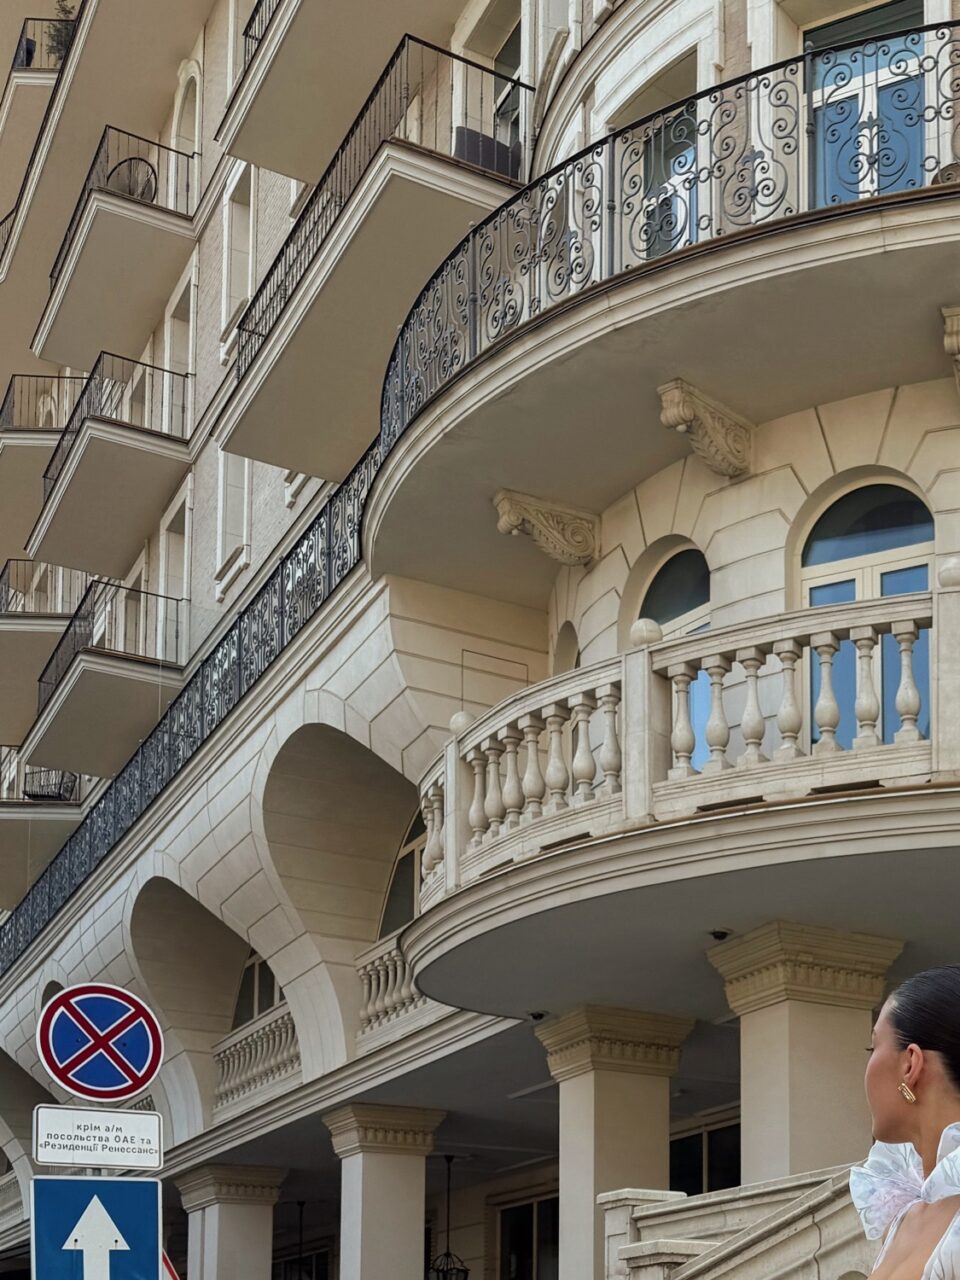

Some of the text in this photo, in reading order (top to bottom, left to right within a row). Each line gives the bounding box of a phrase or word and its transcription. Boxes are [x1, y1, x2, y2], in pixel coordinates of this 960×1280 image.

[77, 1122, 123, 1133] крім а/м
[46, 1132, 152, 1145] посольства ОАЕ та
[39, 1141, 159, 1155] «Резиденції Ренессанс»
